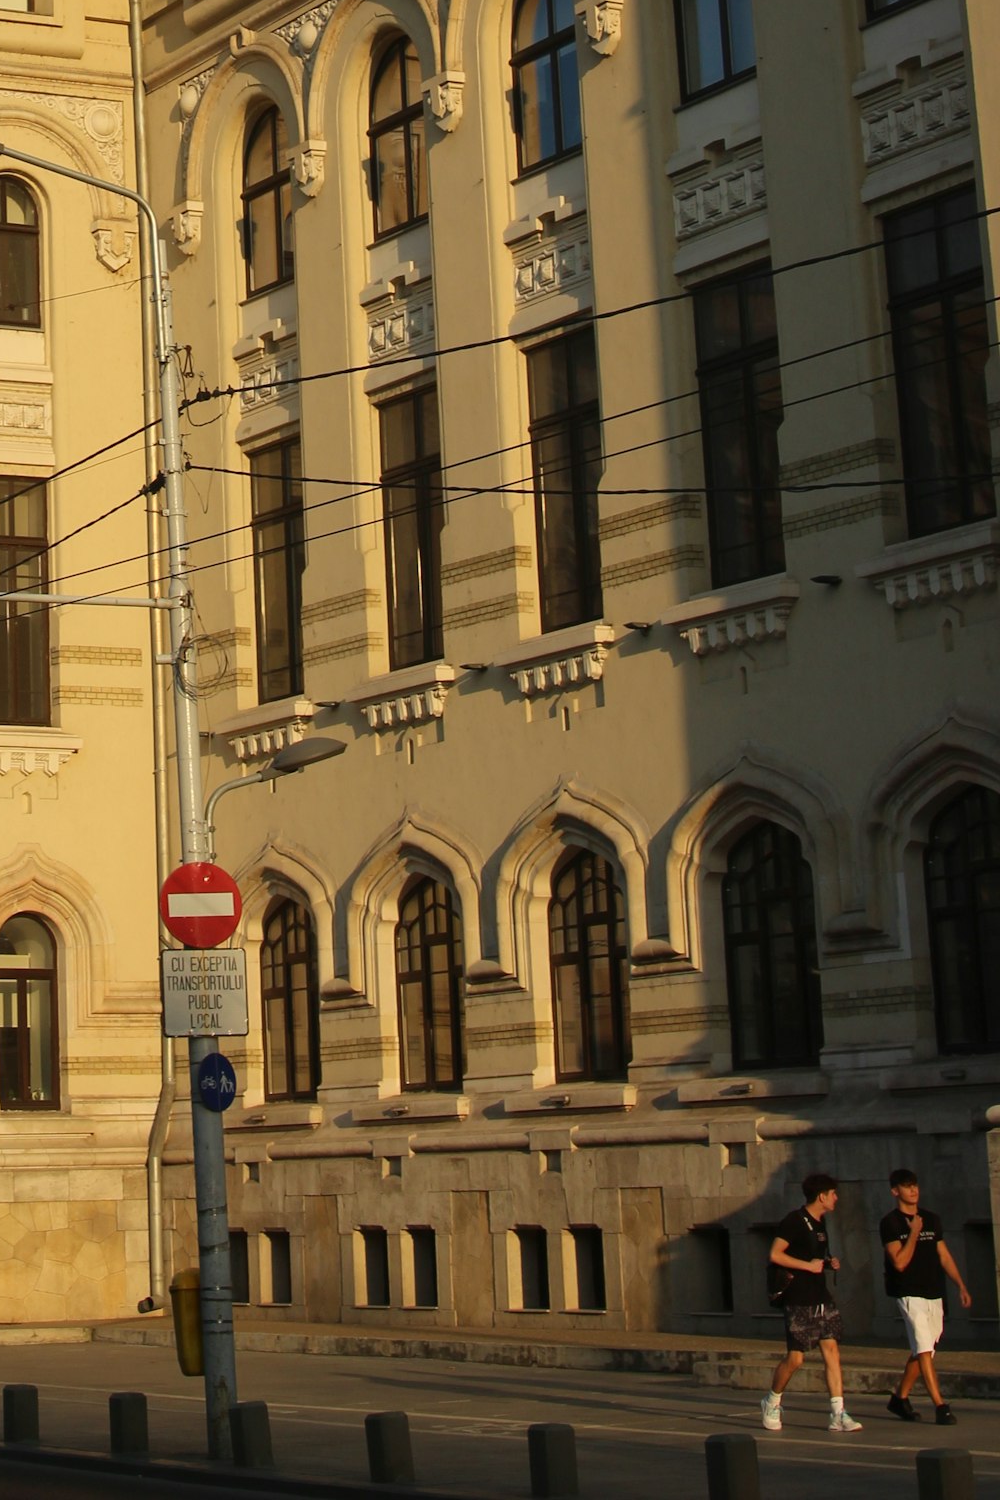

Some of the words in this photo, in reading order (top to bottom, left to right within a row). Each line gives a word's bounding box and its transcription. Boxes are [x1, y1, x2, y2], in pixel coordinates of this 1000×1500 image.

[171, 957, 185, 972] CU
[190, 956, 237, 972] EXCEPTIA
[166, 975, 244, 991] TRANSPORTULUI
[188, 994, 223, 1010] PUBLIC
[190, 1013, 222, 1029] LOCAL
